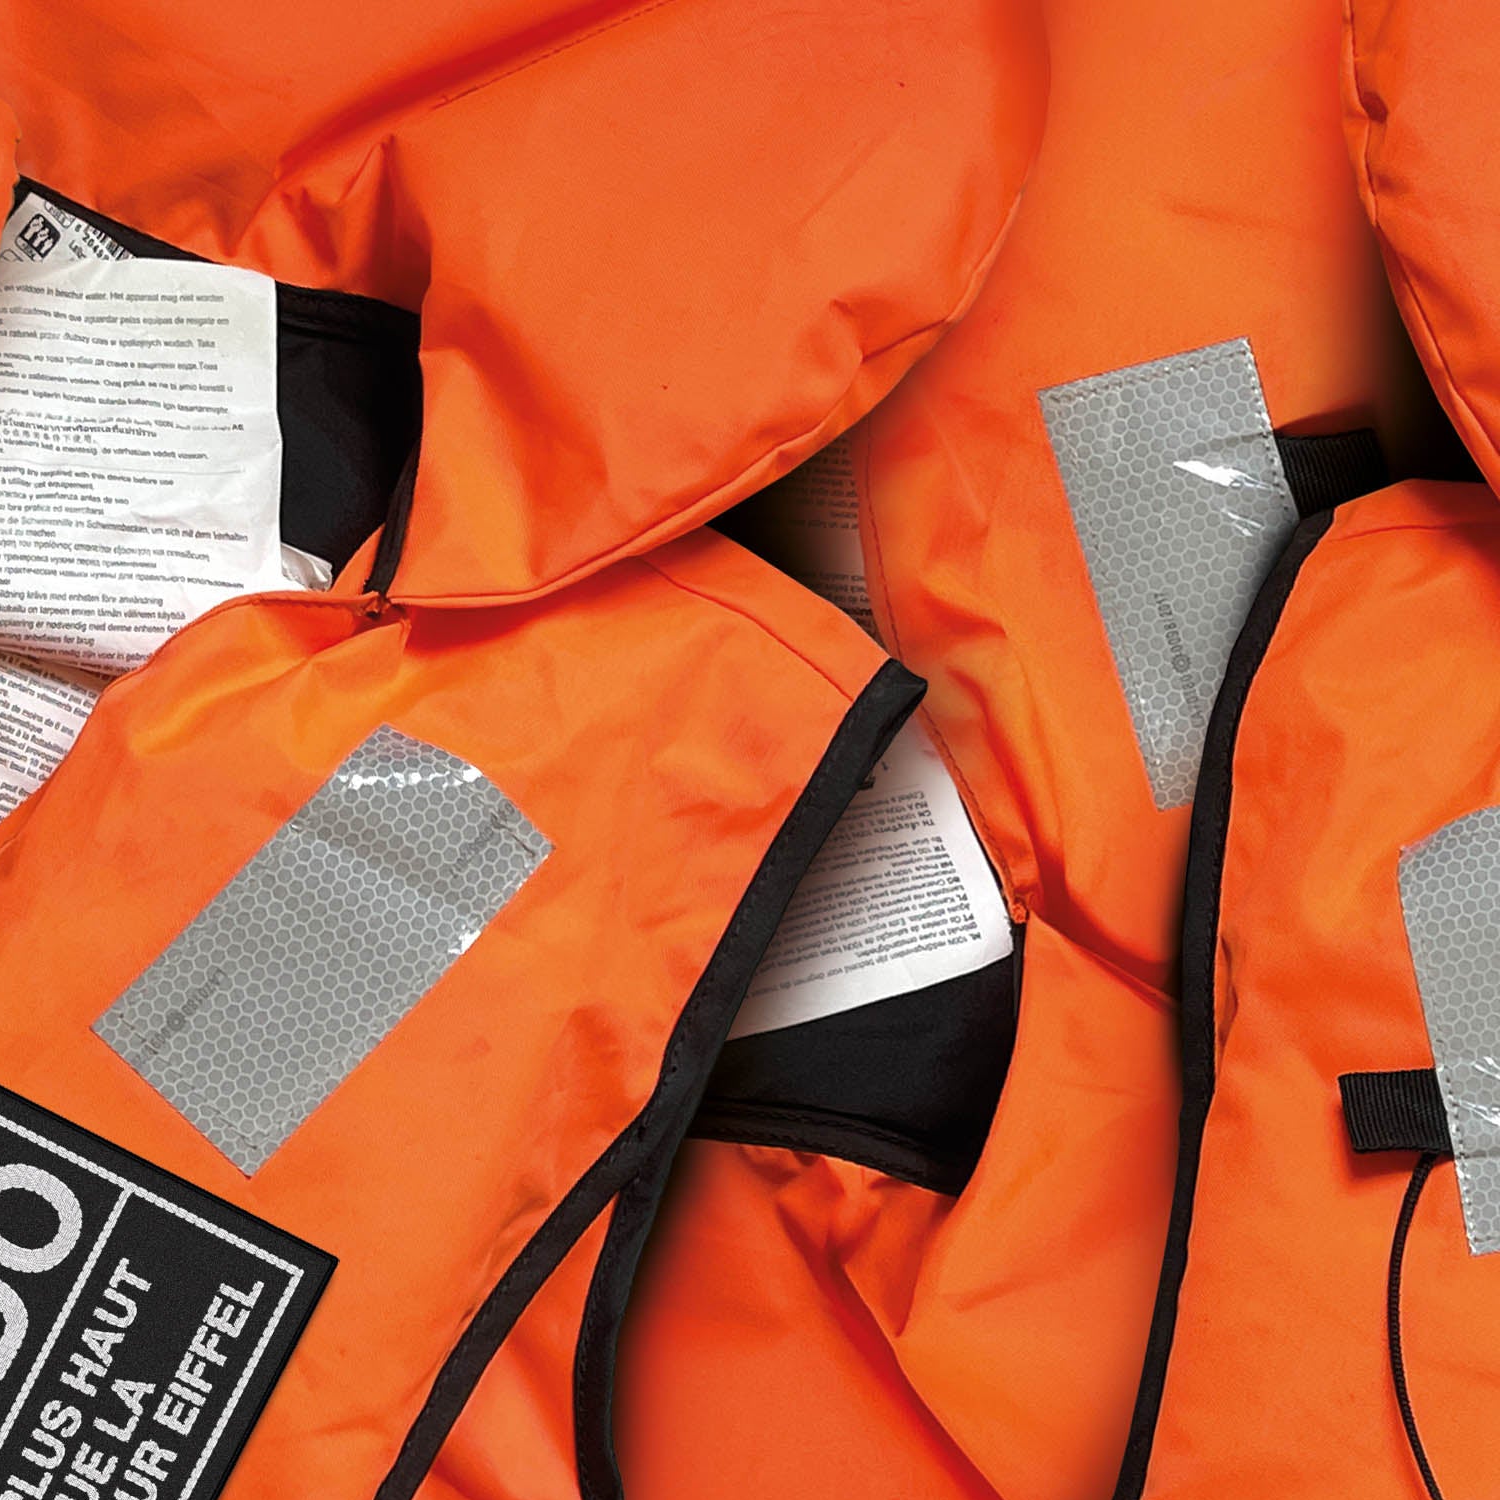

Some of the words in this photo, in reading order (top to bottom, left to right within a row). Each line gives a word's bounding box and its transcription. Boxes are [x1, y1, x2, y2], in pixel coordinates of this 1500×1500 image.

[60, 1257, 152, 1397] HAUT
[153, 1281, 265, 1438] EIFFEL
[93, 1379, 157, 1444] LA
